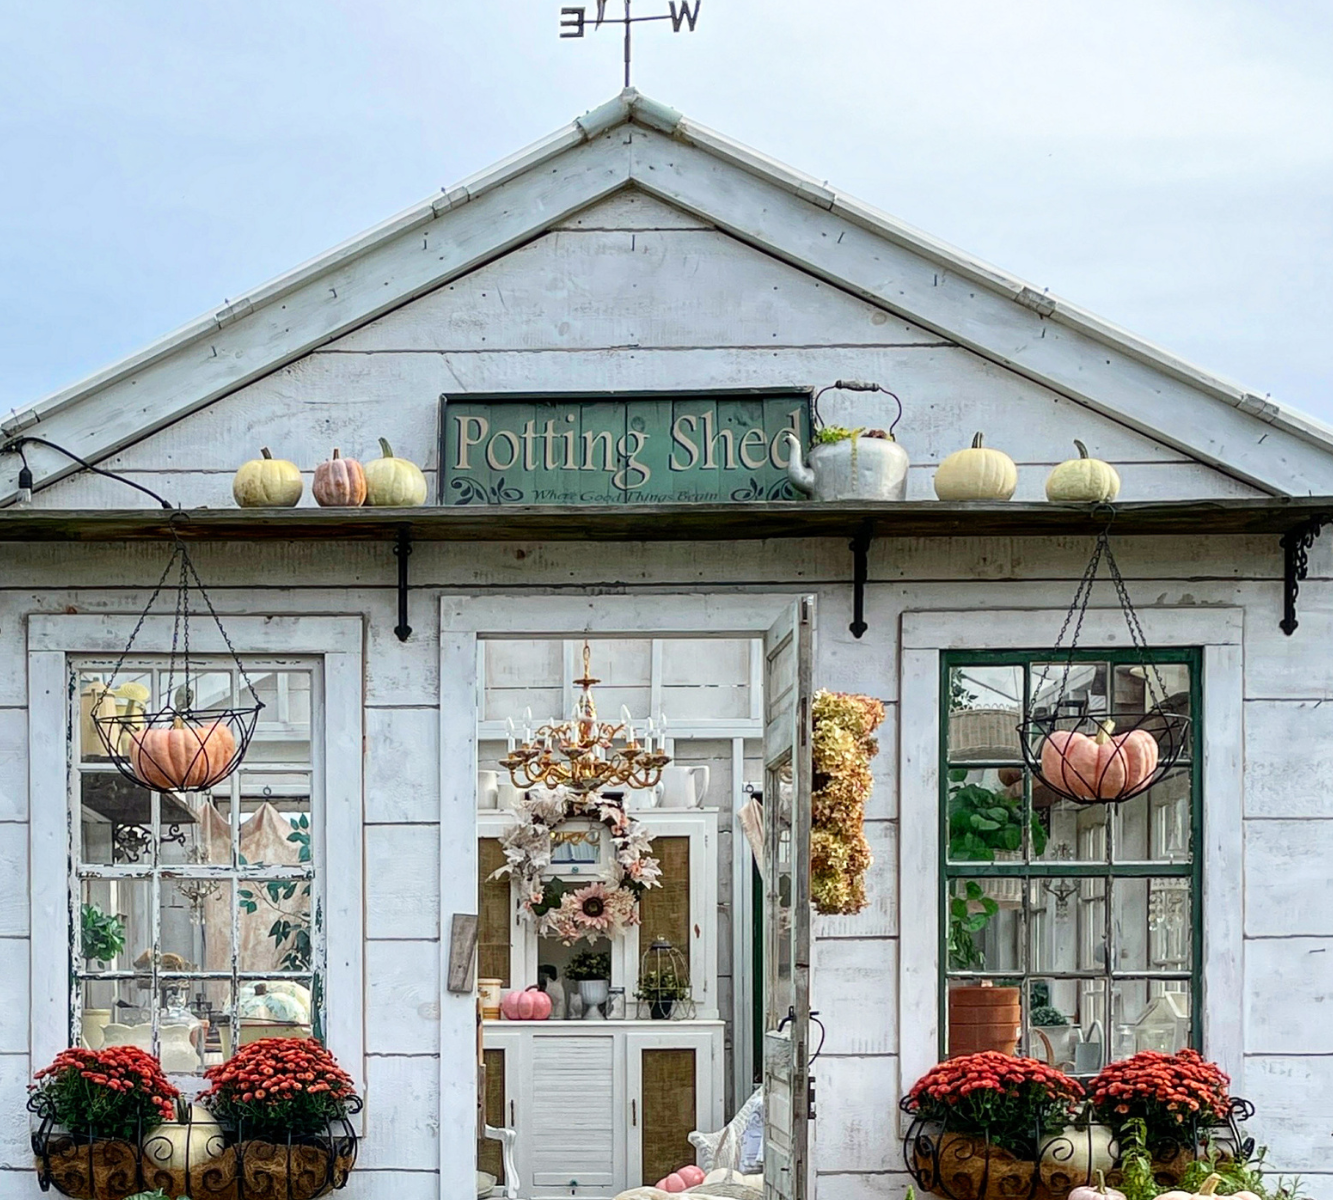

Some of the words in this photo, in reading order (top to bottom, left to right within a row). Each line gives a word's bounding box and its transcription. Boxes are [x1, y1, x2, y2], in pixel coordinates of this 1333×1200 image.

[668, 0, 701, 33] W
[452, 414, 651, 491] Potting
[668, 408, 801, 471] Shed
[533, 489, 578, 501] Where
[580, 490, 622, 502] Good
[626, 490, 674, 503] Things
[676, 490, 719, 503] Begin
